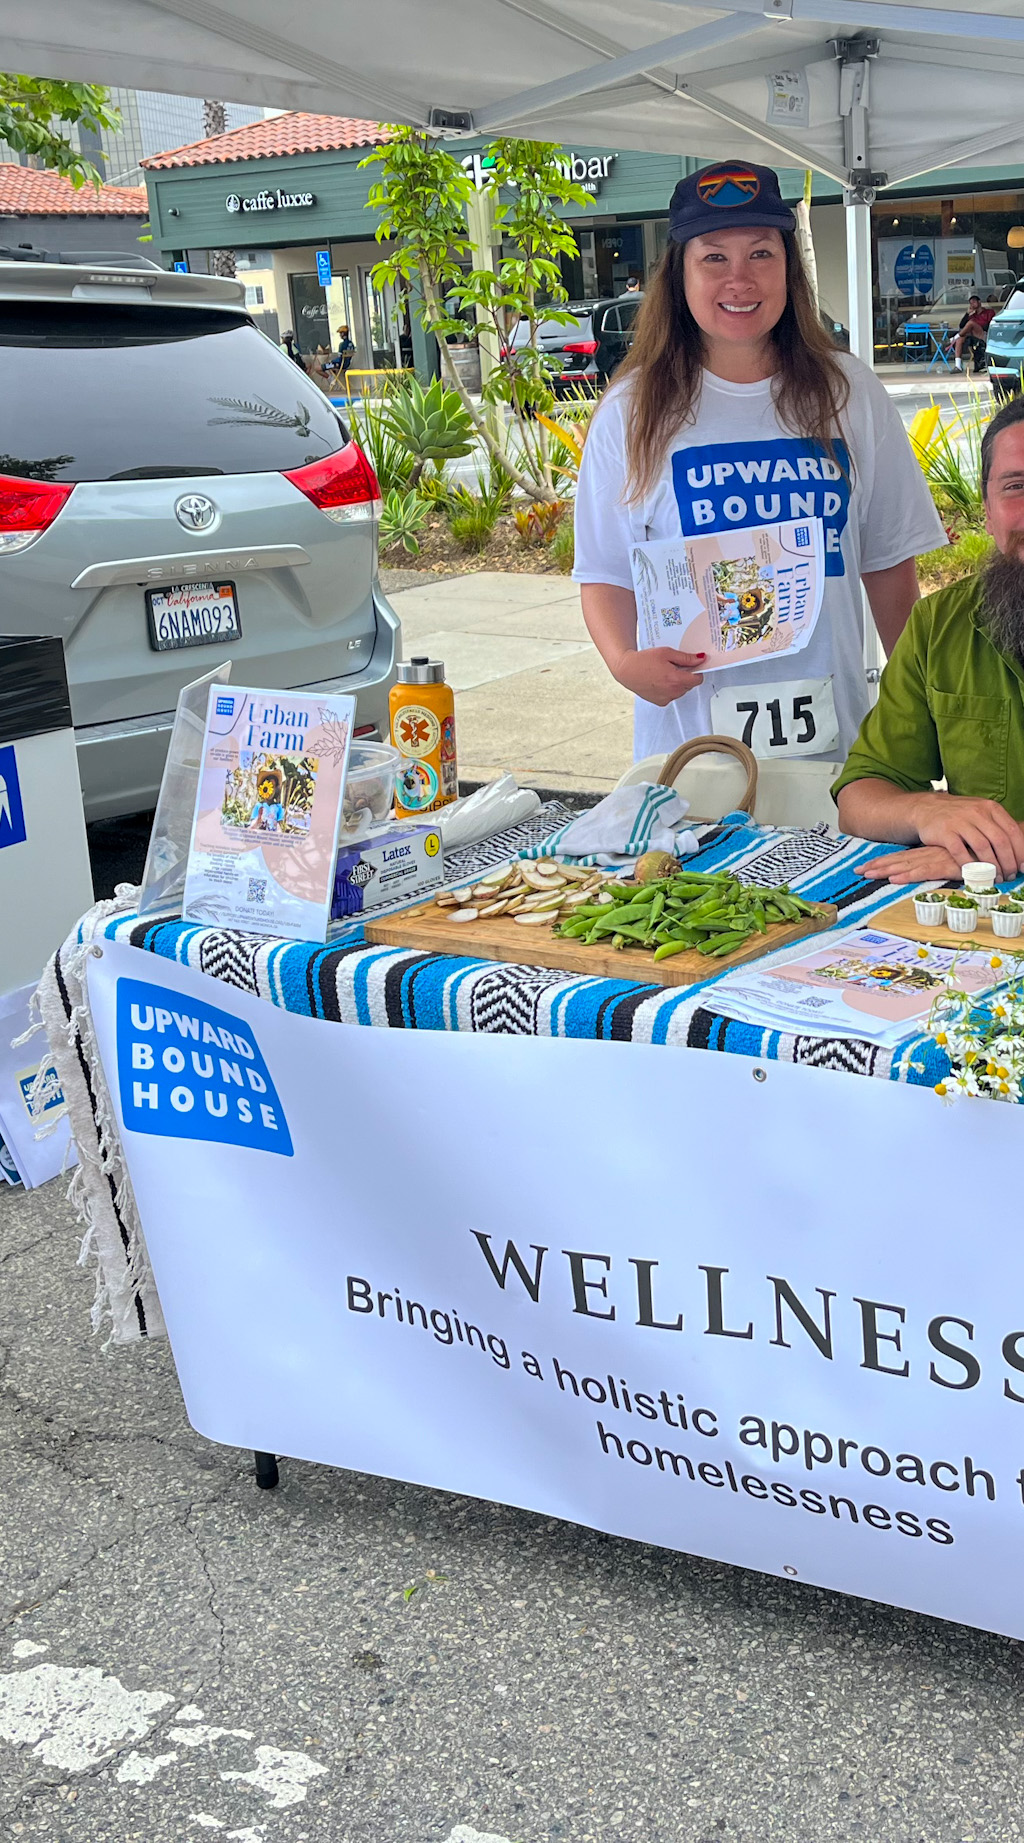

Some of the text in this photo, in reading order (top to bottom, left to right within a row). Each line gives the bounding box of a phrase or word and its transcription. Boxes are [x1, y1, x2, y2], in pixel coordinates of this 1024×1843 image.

[242, 189, 313, 212] caffe luxxe
[686, 457, 842, 489] UPWARD
[691, 491, 842, 527] BOUND
[147, 557, 260, 579] SIENNA
[152, 597, 164, 606] OCT
[167, 591, 215, 608] California
[776, 567, 793, 624] Farm
[793, 562, 811, 622] Urban
[159, 605, 234, 640] 6NAM093
[347, 639, 362, 650] LE
[248, 703, 309, 728] Urban
[736, 695, 816, 748] 715
[247, 725, 304, 752] Farm
[382, 845, 412, 862] Latex
[429, 839, 436, 848] L
[350, 870, 375, 885] STREET
[352, 863, 371, 876] FIRST
[130, 1003, 255, 1060] UPWARD
[131, 1042, 267, 1094] BOUND
[132, 1081, 278, 1130] HOUSE
[346, 1275, 509, 1370] Bringing
[522, 1351, 544, 1381] a
[552, 1356, 719, 1438] holistic
[738, 1411, 997, 1501] approach
[596, 1420, 956, 1546] homelessness
